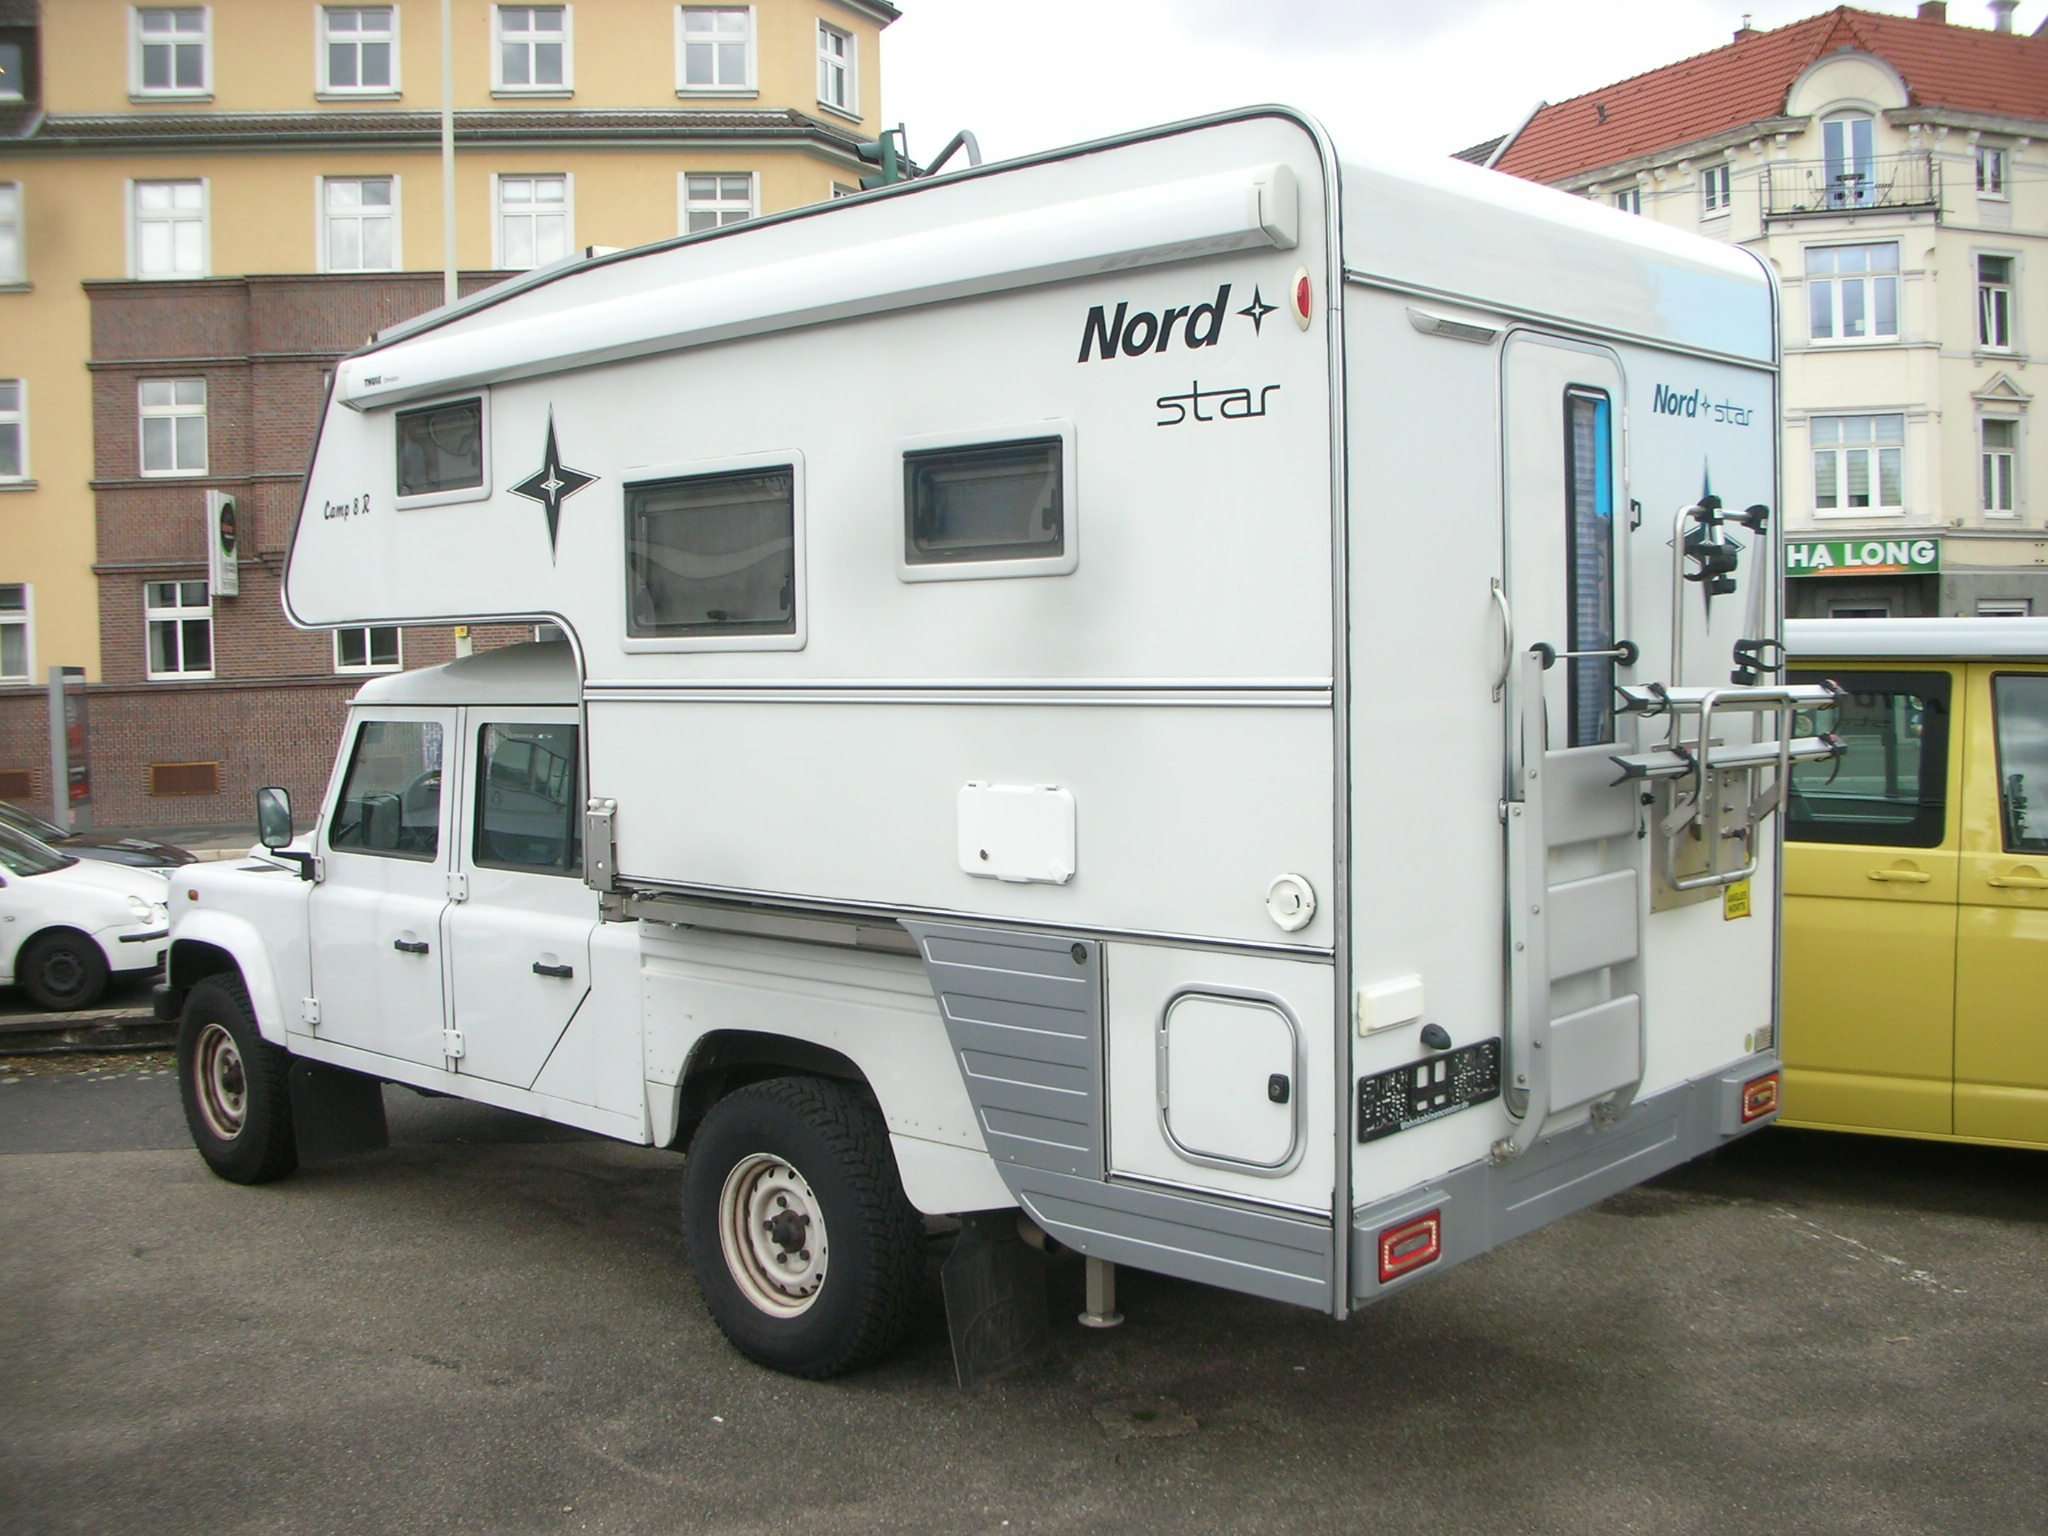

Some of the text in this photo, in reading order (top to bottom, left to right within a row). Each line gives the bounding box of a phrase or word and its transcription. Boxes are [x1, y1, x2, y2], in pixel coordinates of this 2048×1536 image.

[1077, 283, 1232, 364] Nord
[1156, 380, 1281, 426] star
[1652, 383, 1753, 427] Nord star
[323, 493, 371, 522] Camp 8 R
[1844, 540, 1936, 566] LONG
